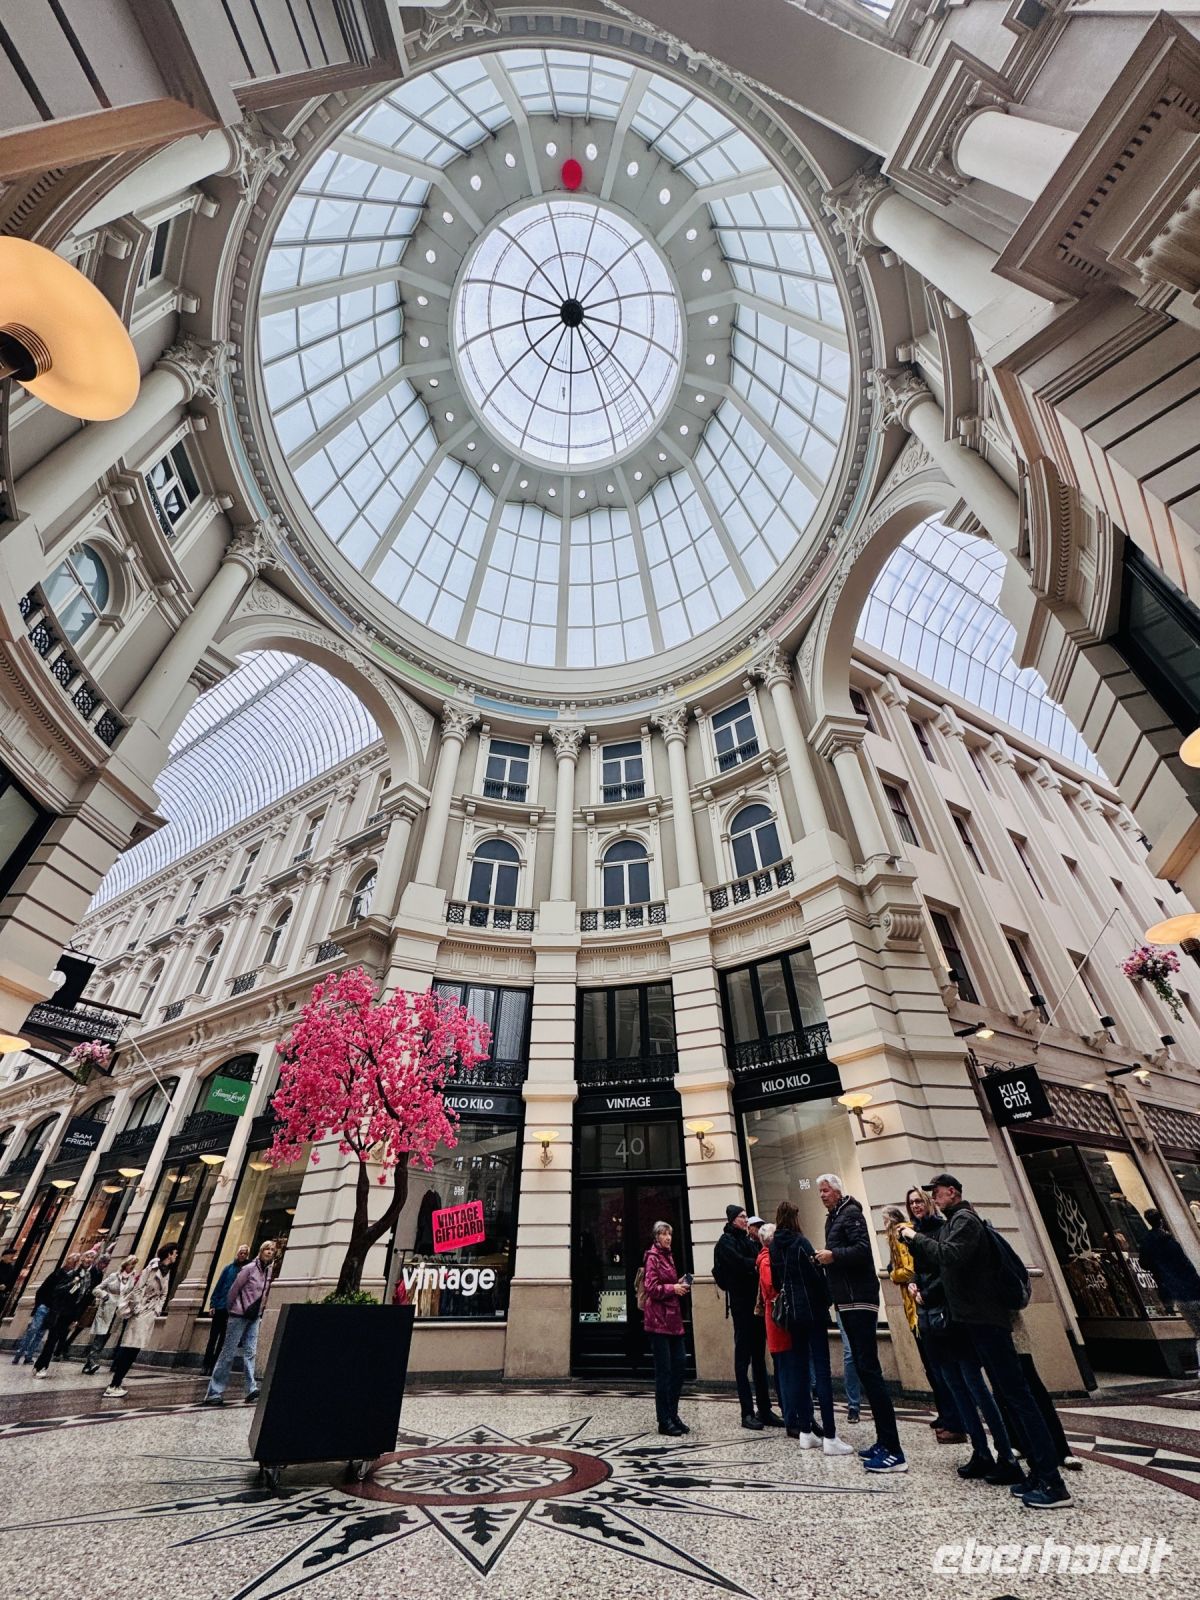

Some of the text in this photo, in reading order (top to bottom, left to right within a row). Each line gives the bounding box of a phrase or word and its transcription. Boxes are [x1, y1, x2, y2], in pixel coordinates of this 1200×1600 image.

[761, 1073, 811, 1093] KILO KILO
[998, 1080, 1026, 1098] KILO
[444, 1096, 494, 1110] KILO KILO
[606, 1096, 651, 1109] VINTAGE
[1012, 1111, 1032, 1119] vintage
[65, 1137, 96, 1147] FRIDAY
[72, 1132, 93, 1140] SAM
[615, 1137, 645, 1164] 40
[437, 1206, 479, 1228] VINTAGE
[435, 1220, 483, 1244] GIFTCARD
[402, 1263, 496, 1297] vintage
